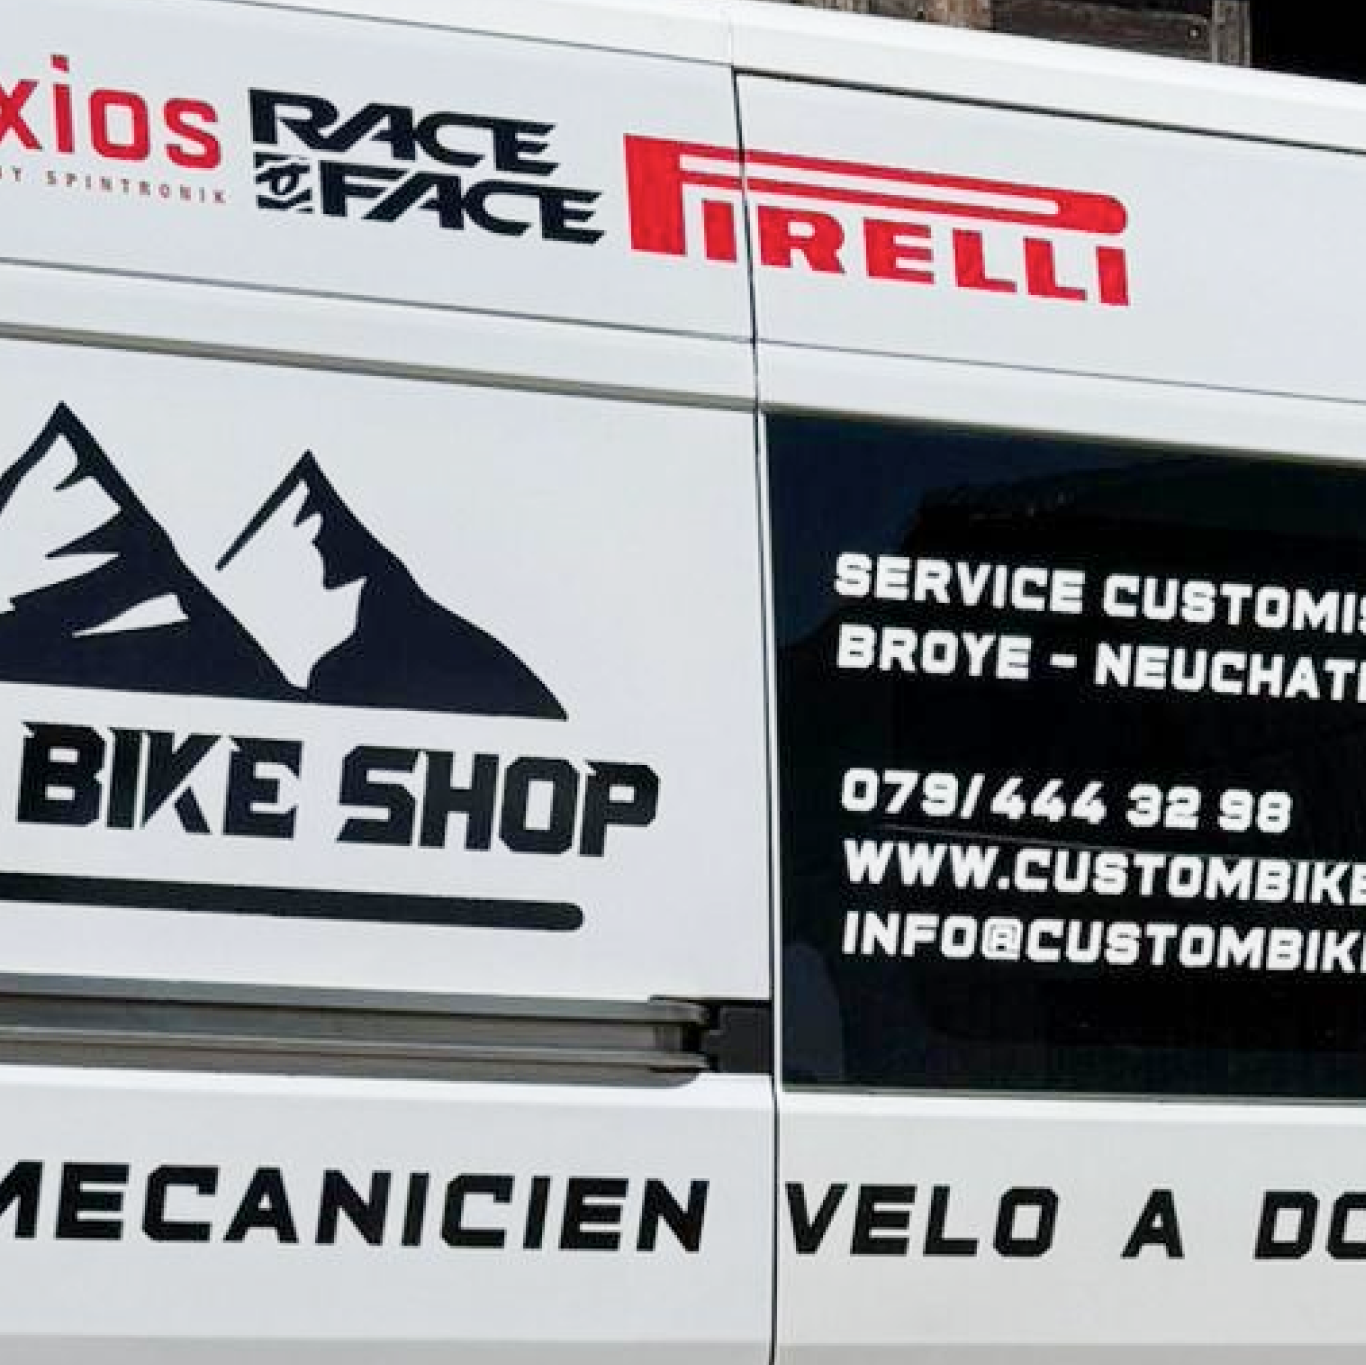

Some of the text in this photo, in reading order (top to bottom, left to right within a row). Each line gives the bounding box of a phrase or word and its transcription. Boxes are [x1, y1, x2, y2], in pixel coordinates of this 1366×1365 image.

[249, 87, 560, 177] RACE
[45, 170, 227, 205] SPINTRONIK
[320, 159, 606, 246] FACE
[623, 133, 1130, 307] PIRELLI
[835, 553, 1086, 614] SERVICE
[838, 624, 1032, 680] BROYE
[17, 721, 304, 839] BIKE
[336, 745, 660, 858] SHOP
[841, 767, 1292, 833] 079/444 32 98
[784, 1182, 1060, 1258] VELO
[1121, 1188, 1184, 1258] A
